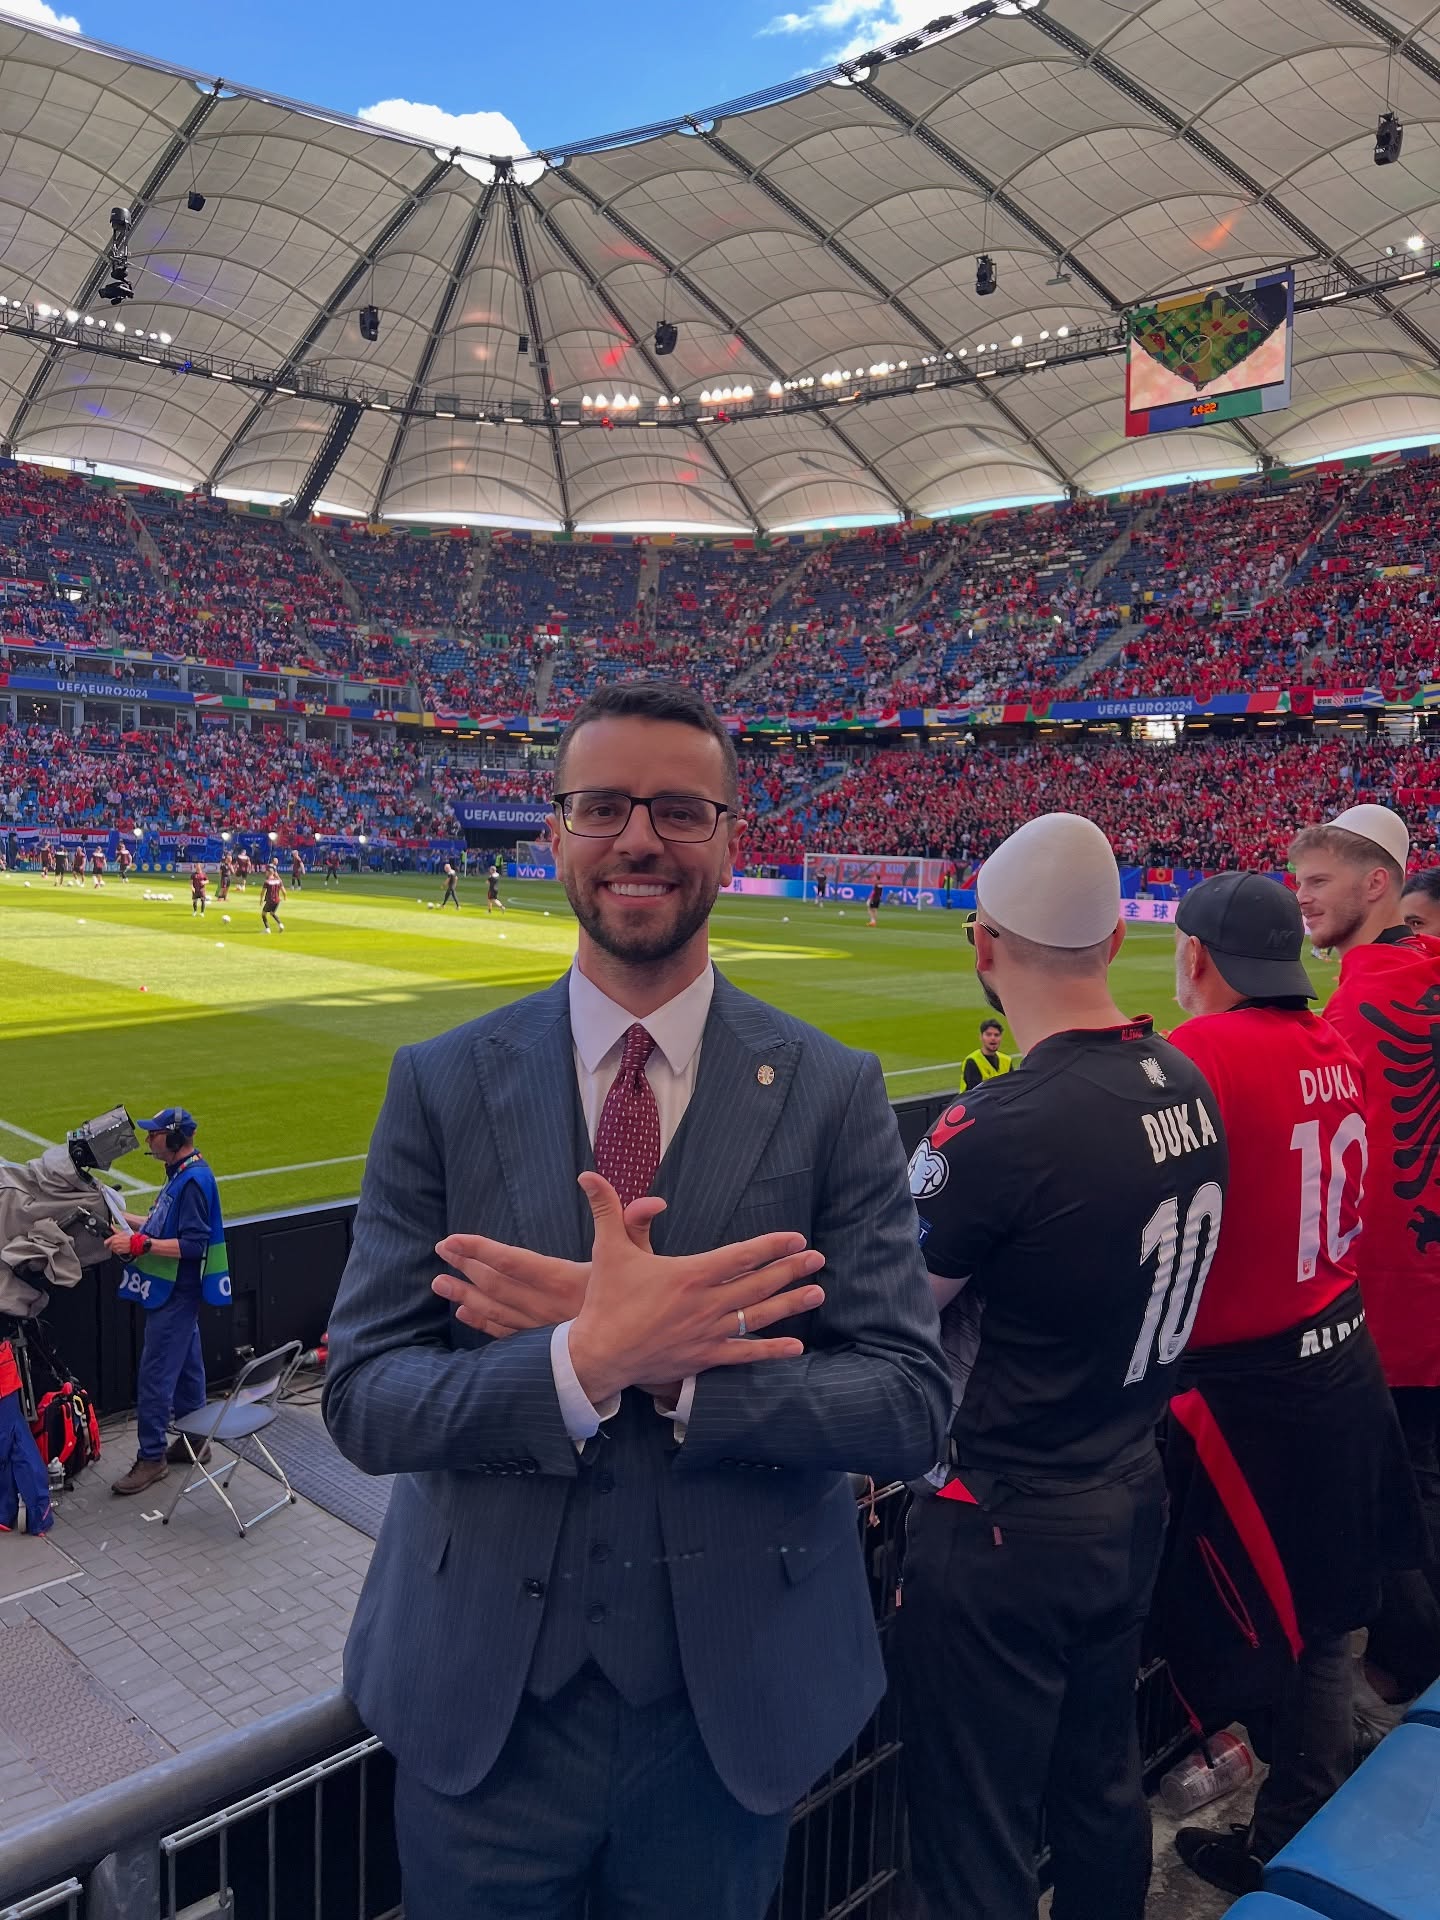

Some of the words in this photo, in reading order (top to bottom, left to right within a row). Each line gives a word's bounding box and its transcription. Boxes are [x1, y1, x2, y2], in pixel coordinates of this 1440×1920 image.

[518, 865, 546, 878] vivo
[1300, 1064, 1359, 1105] DUKA
[1141, 1098, 1218, 1164] DUKA
[1289, 1113, 1369, 1283] 10
[1123, 1182, 1223, 1388] 10
